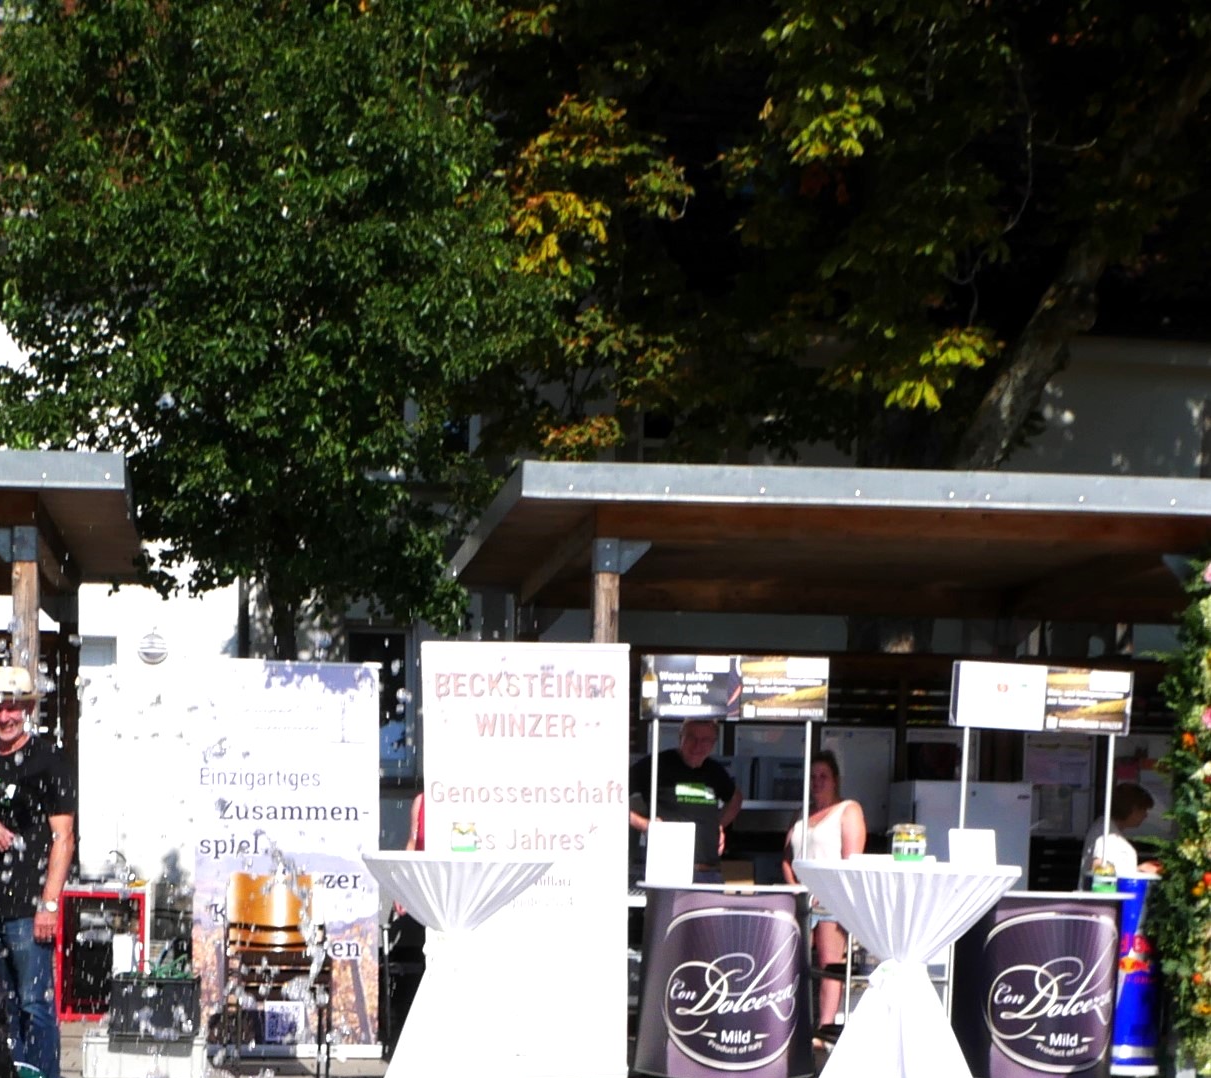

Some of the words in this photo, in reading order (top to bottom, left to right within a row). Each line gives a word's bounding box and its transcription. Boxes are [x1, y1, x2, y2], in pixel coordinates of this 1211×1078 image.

[435, 672, 616, 698] BECKSTEINER
[670, 693, 702, 705] Wein
[475, 713, 576, 738] WINZER
[199, 767, 321, 791] Einzigartiges
[430, 779, 624, 804] Genossenschaft
[218, 800, 369, 822] Zusammen-
[474, 832, 496, 851] es
[670, 978, 698, 1001] Con
[994, 982, 1025, 1005] Con
[707, 1038, 738, 1055] Product
[738, 1044, 748, 1055] of
[721, 1030, 752, 1045] Mild
[1049, 1033, 1079, 1047] Mild
[1035, 1042, 1066, 1057] Product
[1065, 1048, 1075, 1057] of
